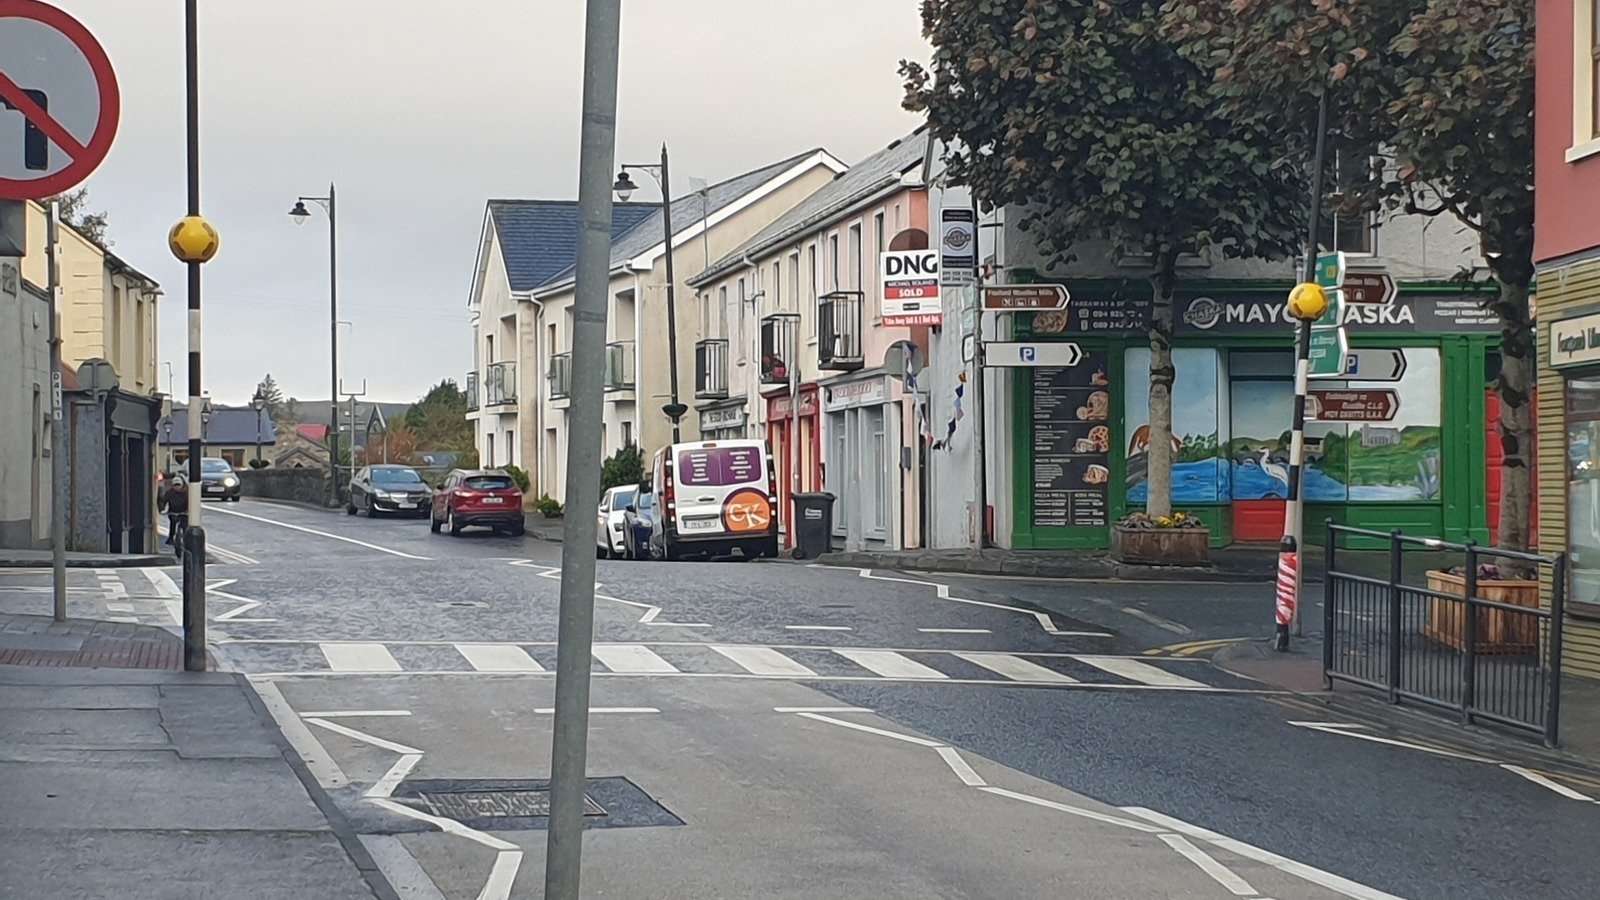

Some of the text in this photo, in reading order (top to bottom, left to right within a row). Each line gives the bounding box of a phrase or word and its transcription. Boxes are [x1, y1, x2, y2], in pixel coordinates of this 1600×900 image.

[886, 253, 938, 276] DNG
[899, 288, 923, 298] SOLD
[1023, 349, 1033, 361] P
[1346, 356, 1356, 372] P
